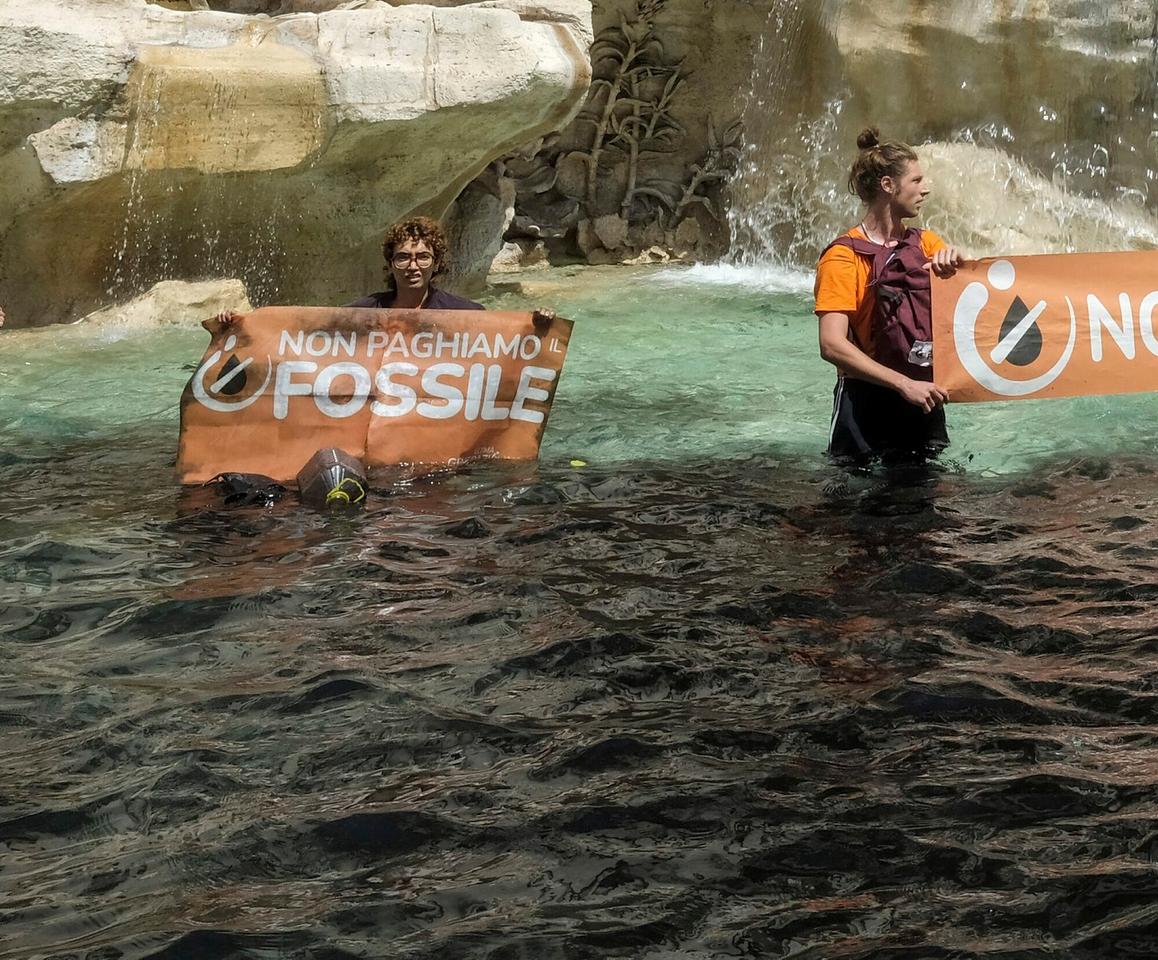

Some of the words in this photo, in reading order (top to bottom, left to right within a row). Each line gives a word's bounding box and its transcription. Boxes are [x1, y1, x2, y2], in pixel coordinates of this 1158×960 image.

[278, 329, 357, 358] NON
[366, 331, 542, 361] PAGHIAMO
[549, 337, 562, 354] IL
[273, 360, 556, 424] FOSSILE
